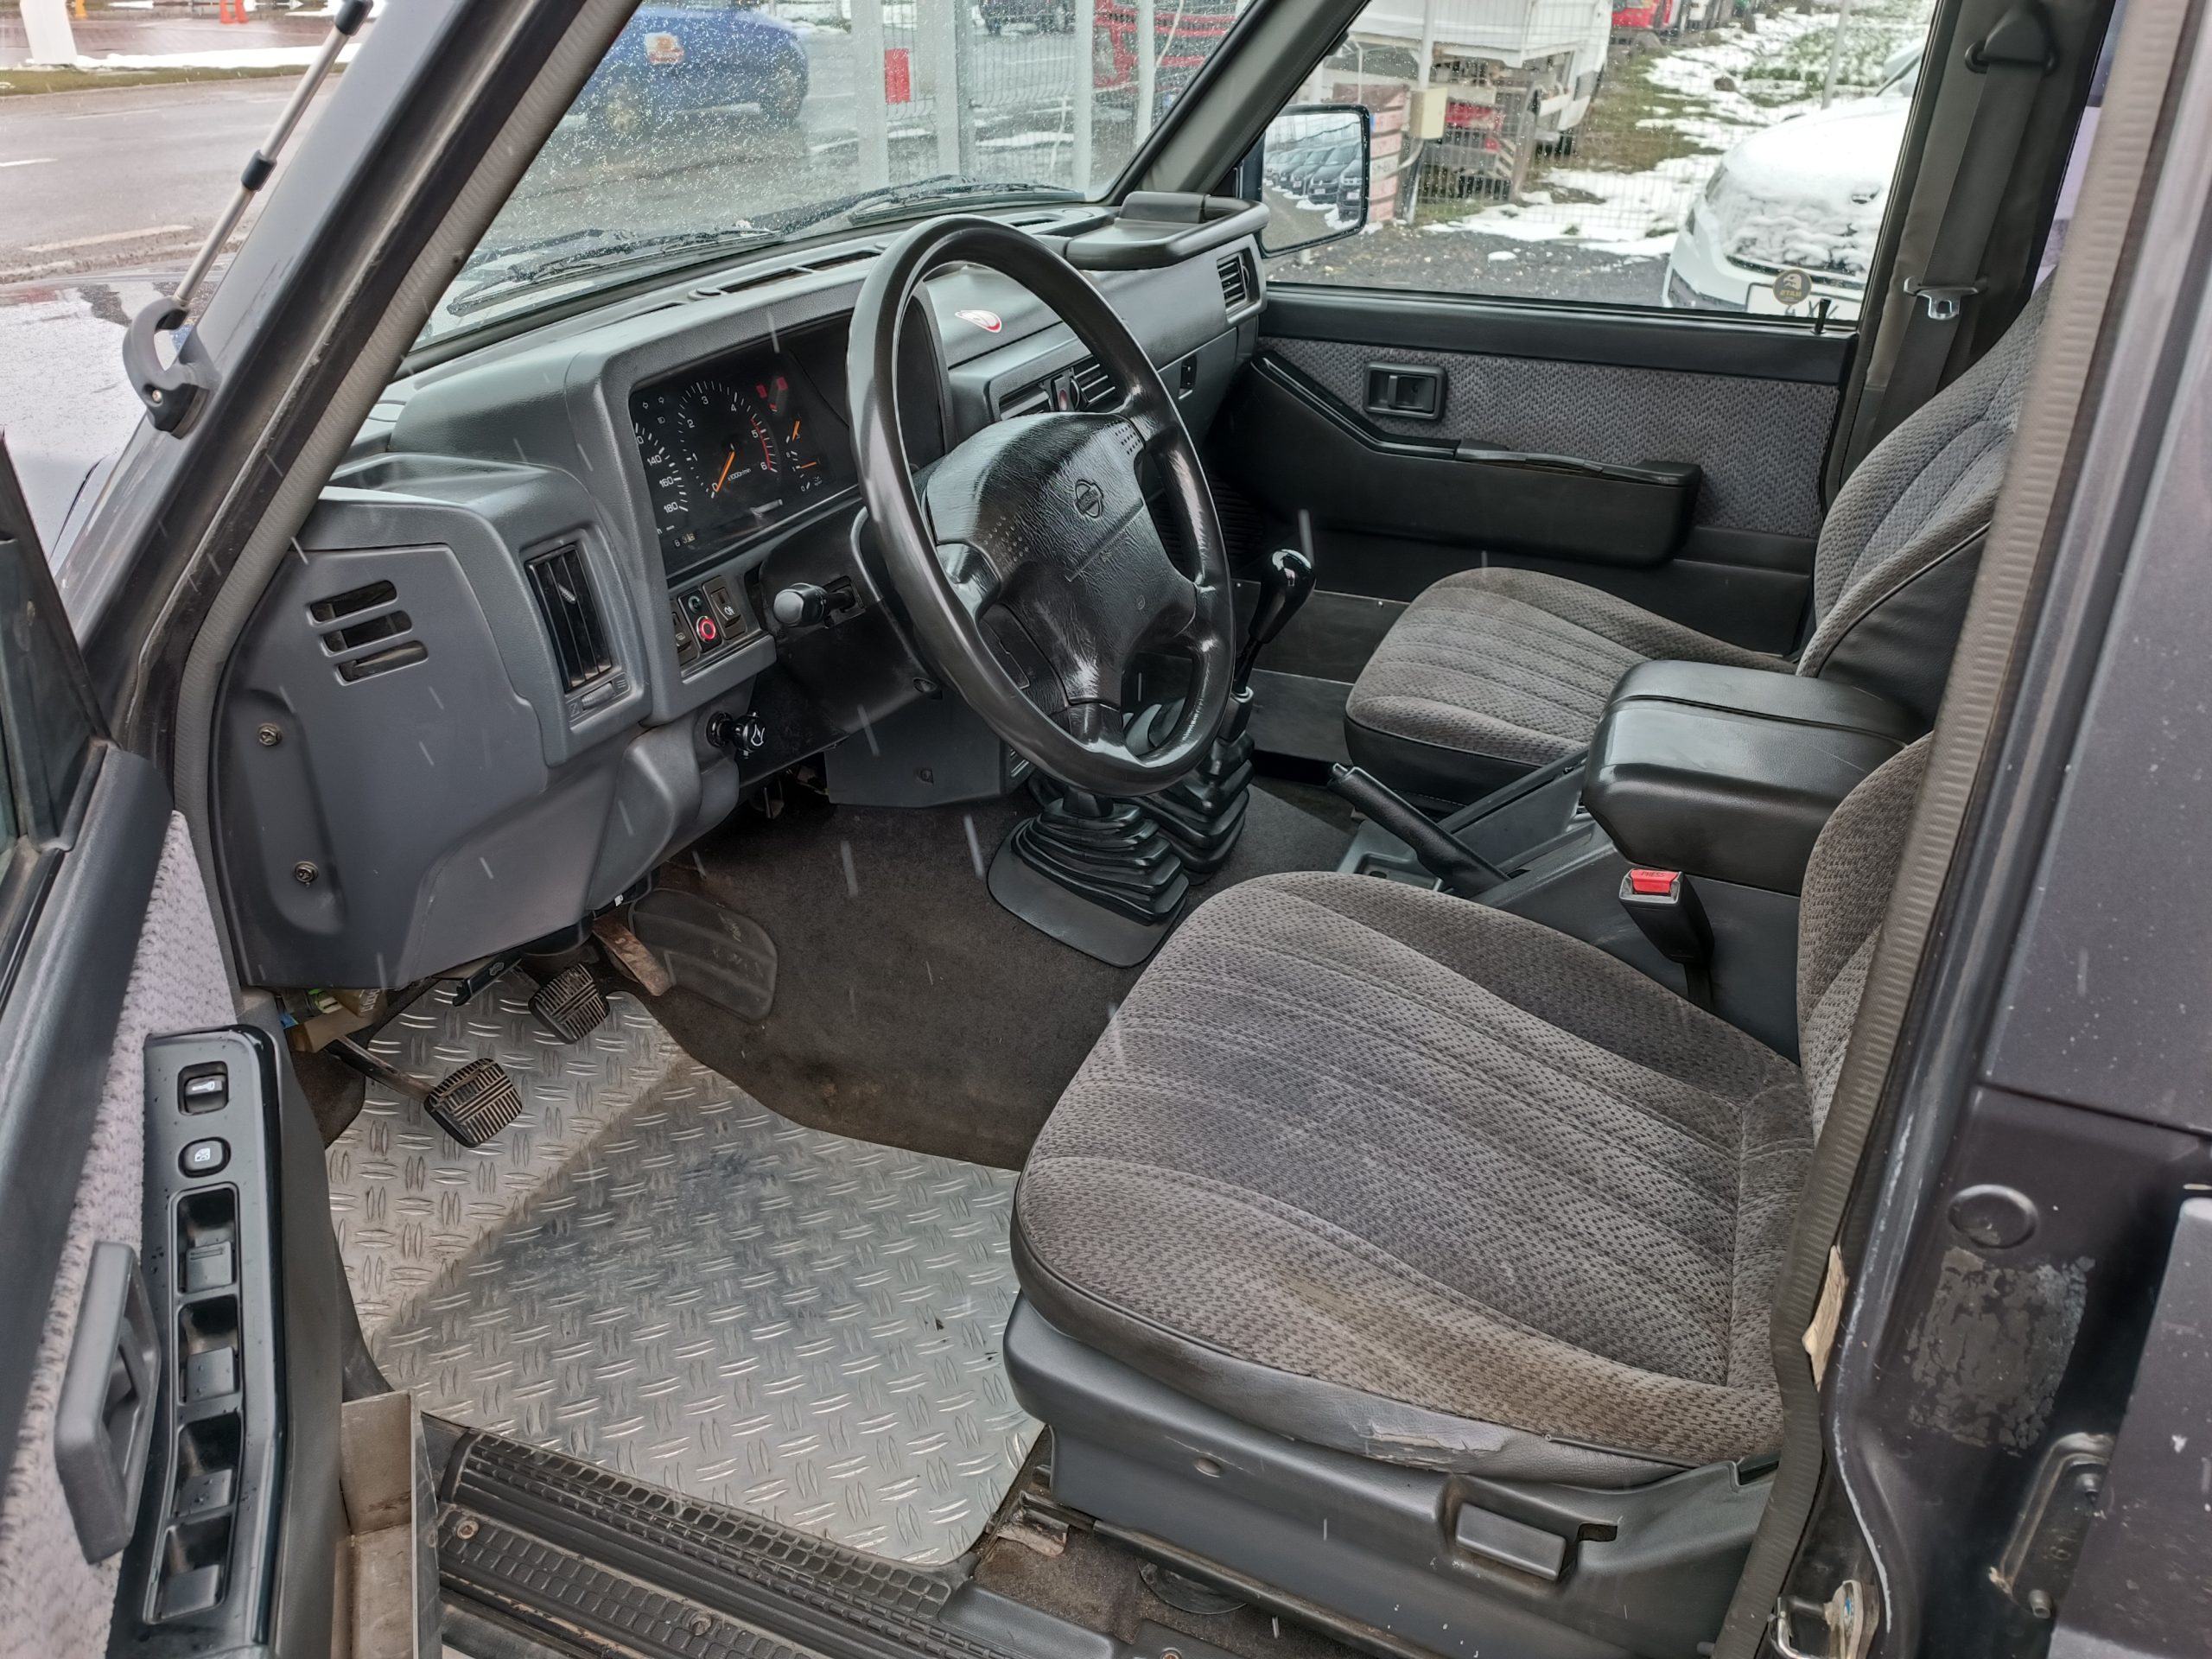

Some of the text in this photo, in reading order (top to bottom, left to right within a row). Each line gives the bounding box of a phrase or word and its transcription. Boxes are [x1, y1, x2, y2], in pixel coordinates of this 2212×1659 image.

[701, 396, 709, 405] 3
[730, 404, 737, 412] 4
[687, 419, 695, 429] 2
[751, 429, 759, 438] 5
[646, 455, 662, 466] 140
[760, 461, 767, 471] 6
[658, 478, 674, 488] 160
[664, 502, 678, 512] 180
